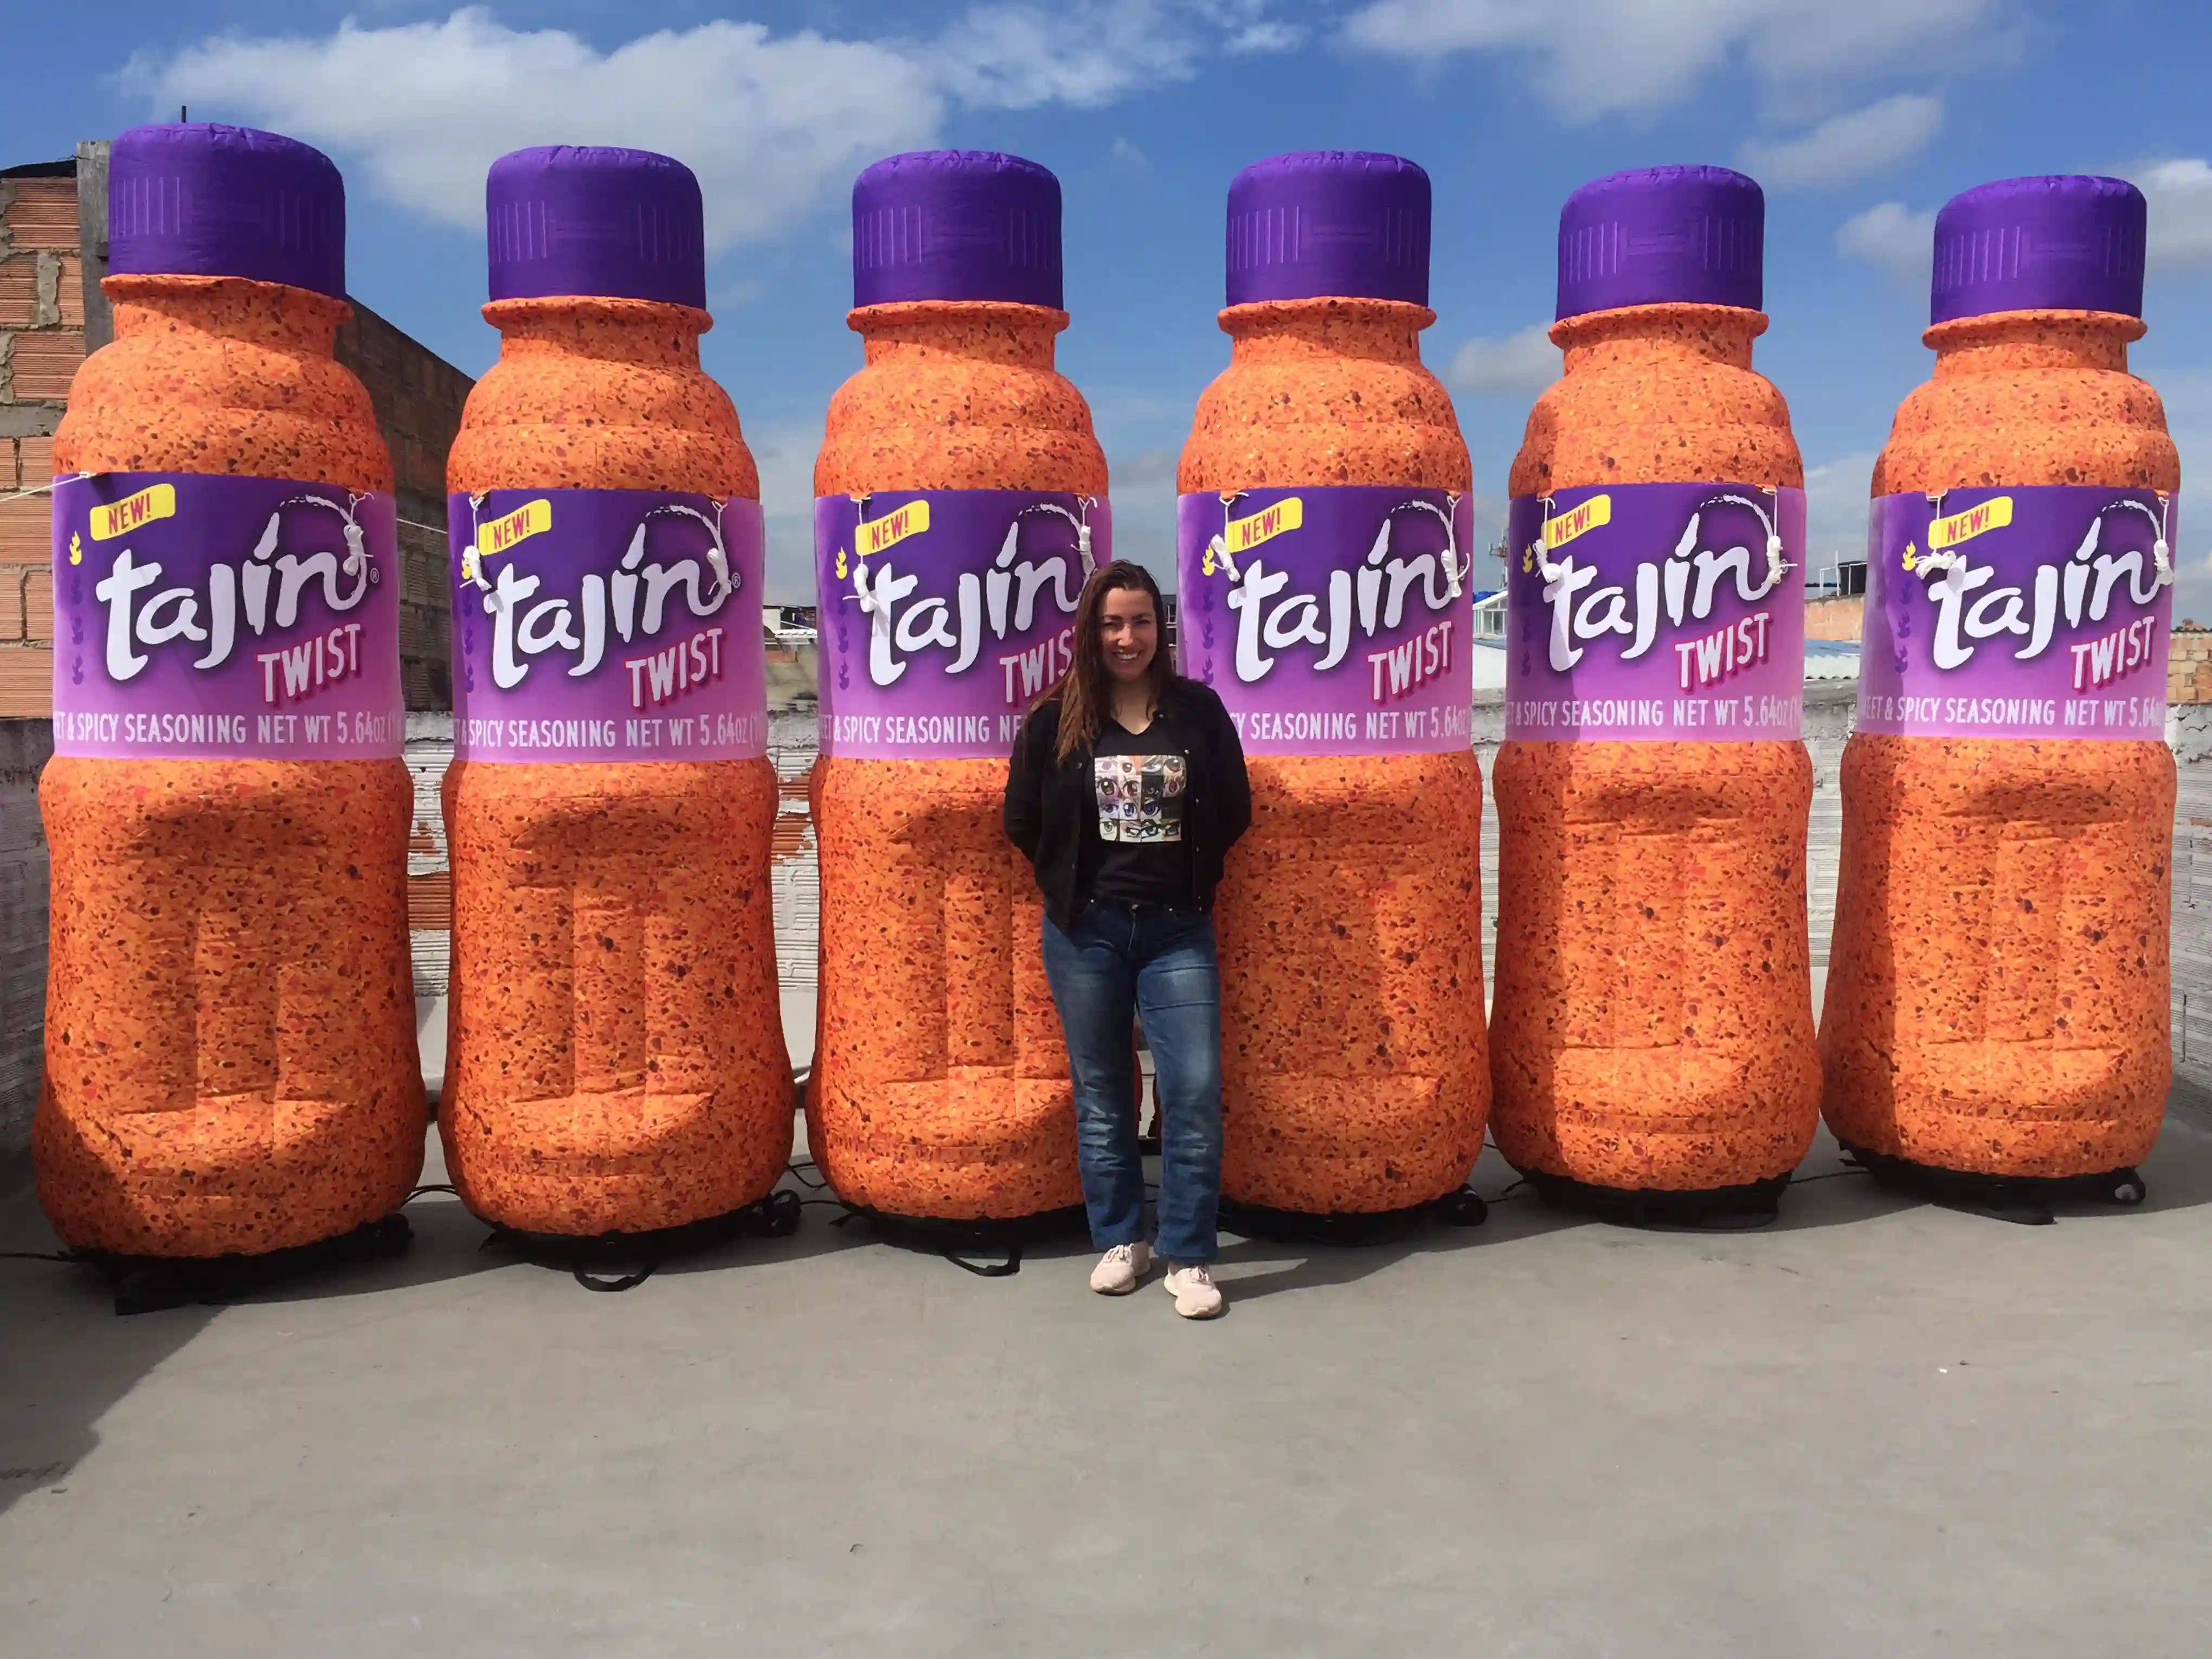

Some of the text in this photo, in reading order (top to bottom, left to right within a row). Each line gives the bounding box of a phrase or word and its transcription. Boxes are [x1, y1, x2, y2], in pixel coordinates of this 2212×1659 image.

[108, 498, 151, 535] NEW!
[493, 509, 531, 549] NEW!
[871, 513, 910, 550] NEW!
[1242, 509, 1282, 547] NEW!
[1554, 504, 1591, 544] NEW!
[1946, 506, 1990, 543] NEW!
[257, 623, 362, 703] TWIST
[625, 627, 724, 708] TWIST
[999, 626, 1076, 703] TWIS
[1367, 621, 1453, 700] TWIST
[1675, 612, 1770, 689] TWIST
[2070, 615, 2156, 689] TWIST
[77, 712, 119, 742] SPICY
[124, 713, 247, 744] SEASONING
[257, 714, 297, 744] NET
[303, 715, 331, 744] WT
[843, 715, 882, 743] SPICY
[885, 716, 990, 744] SEASONING
[999, 715, 1023, 743] NE
[1250, 712, 1356, 740] SEASONING
[1366, 712, 1399, 740] NET
[1404, 711, 1427, 739] WT
[1523, 700, 1558, 726] SPICY
[1560, 700, 1664, 727] SEASONING
[1673, 699, 1706, 726] NET
[1714, 699, 1739, 726] WT
[1896, 696, 1941, 723] SPICY
[1946, 696, 2056, 725] SEASONING
[2063, 699, 2100, 726] NET
[2102, 699, 2126, 727] WT
[468, 718, 504, 747] SPICY
[508, 718, 616, 748] SEASONING
[625, 718, 663, 747] NET
[668, 718, 695, 747] WT
